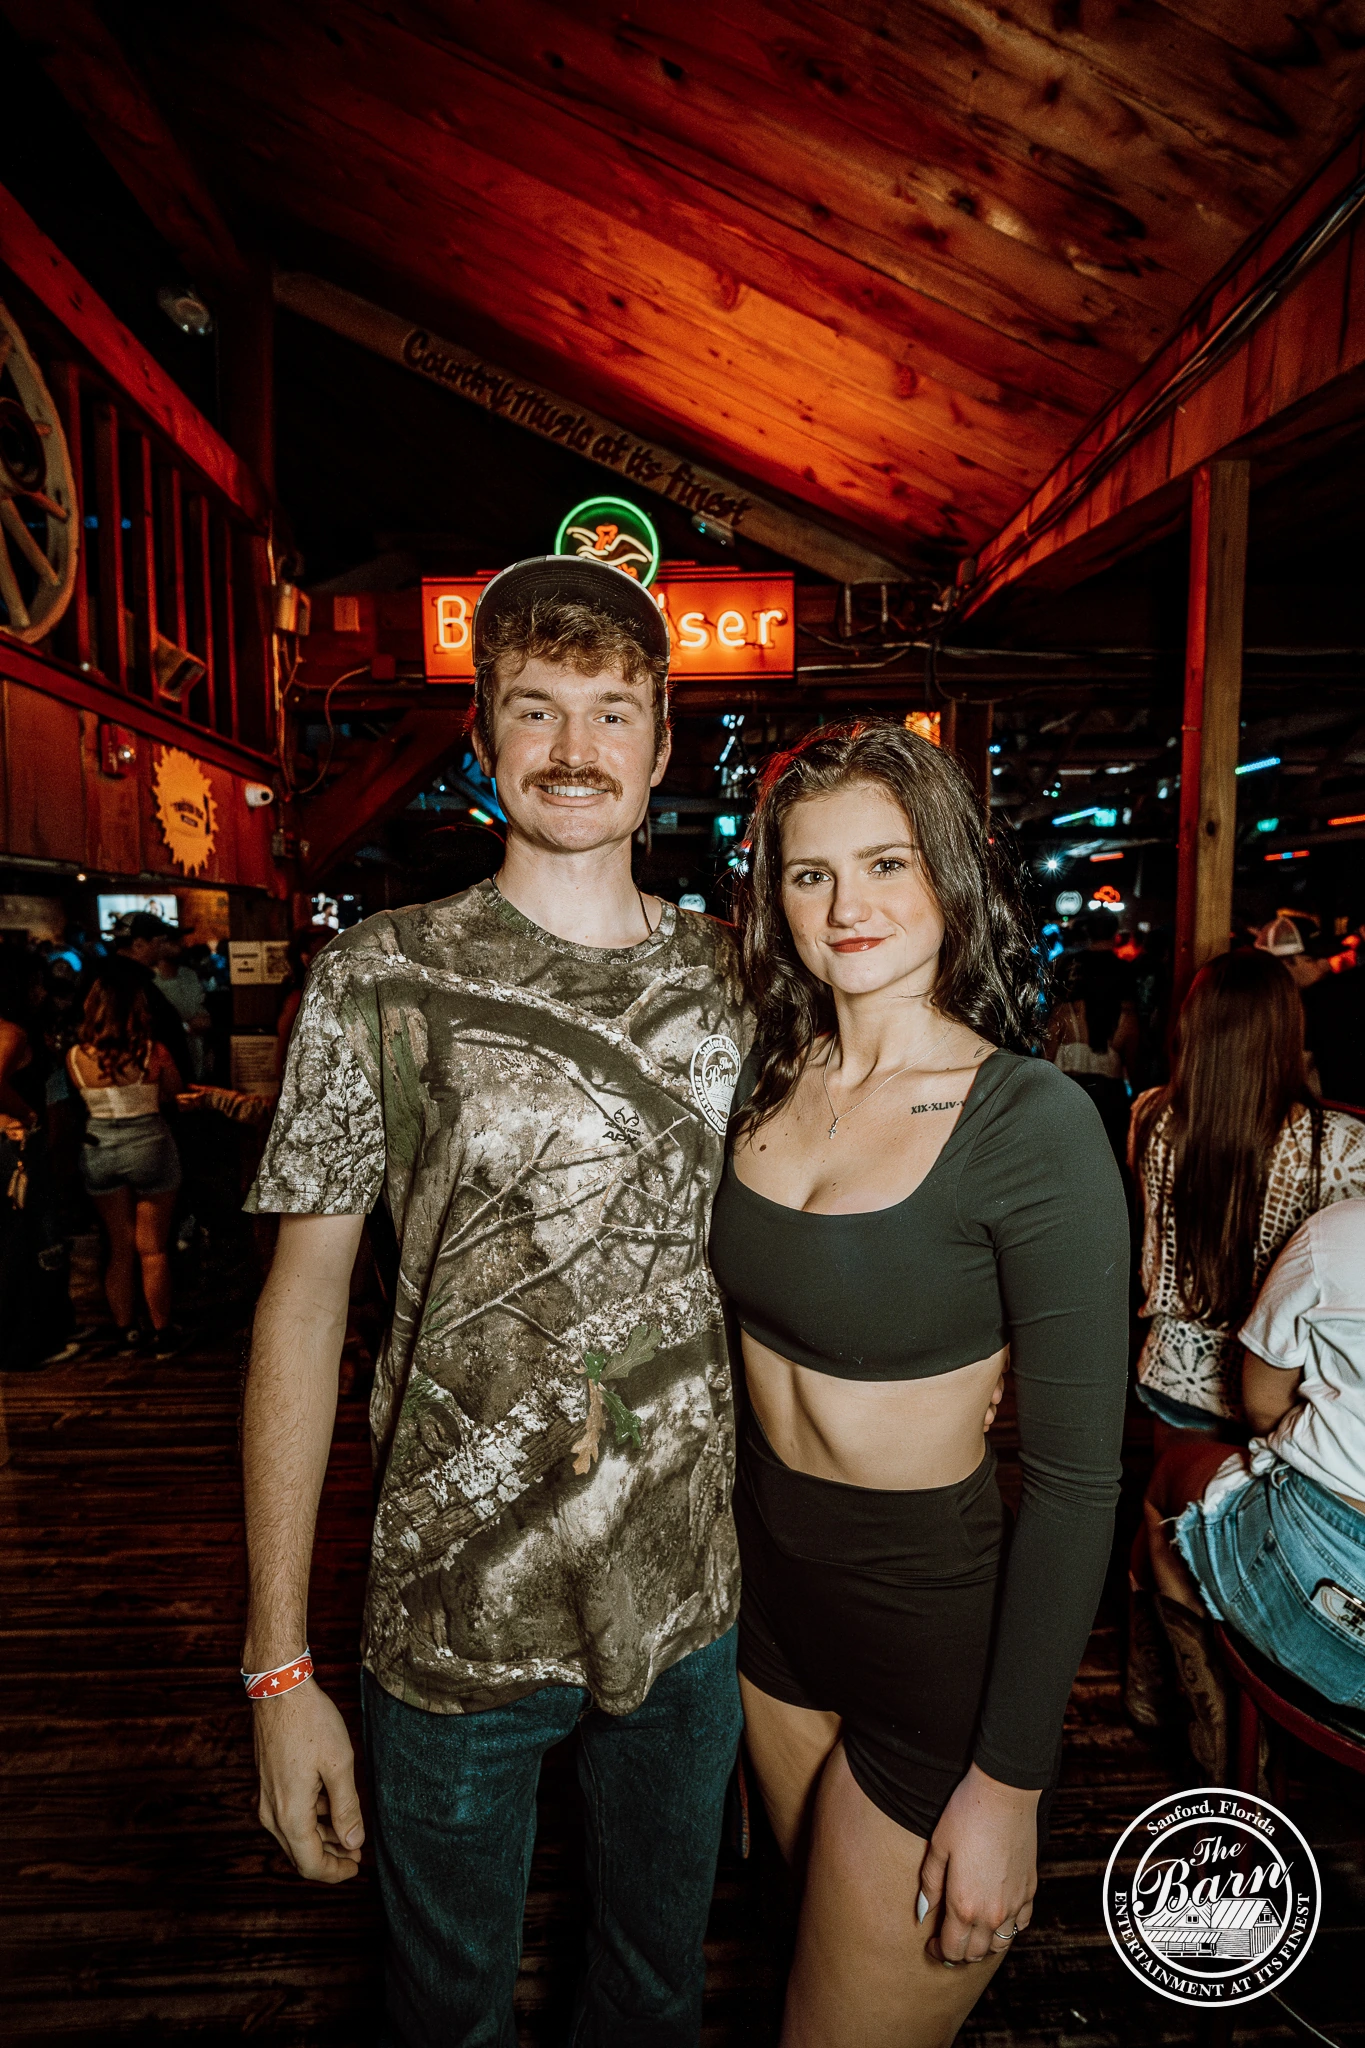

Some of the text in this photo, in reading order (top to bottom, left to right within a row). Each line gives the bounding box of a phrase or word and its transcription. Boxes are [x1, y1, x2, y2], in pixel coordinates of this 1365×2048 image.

[401, 330, 513, 409] Country
[592, 432, 629, 466] at
[624, 447, 664, 482] its
[663, 461, 753, 527] finest
